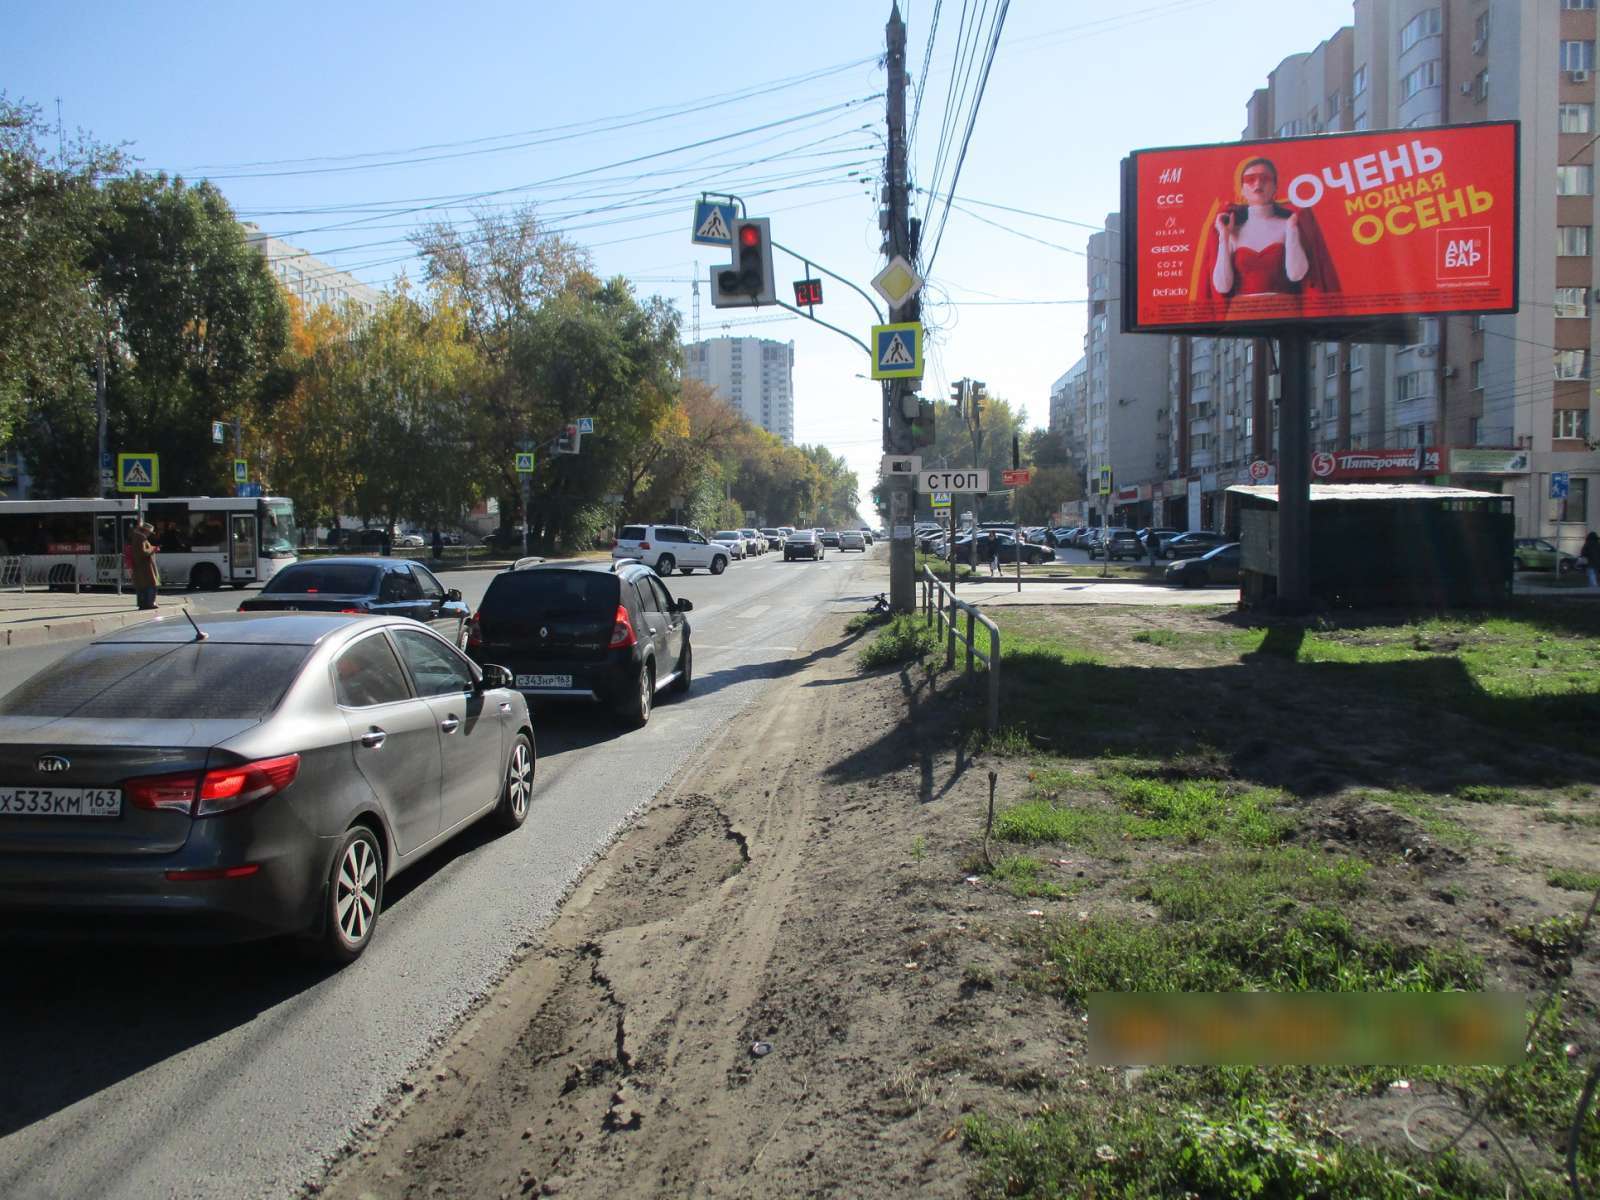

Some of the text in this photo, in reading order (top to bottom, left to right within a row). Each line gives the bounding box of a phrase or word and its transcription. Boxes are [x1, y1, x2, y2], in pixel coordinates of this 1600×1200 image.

[1287, 140, 1443, 208] ОЧЕНЬ
[1156, 193, 1184, 205] CCC
[1344, 171, 1446, 216] МОДНАЯ
[1352, 184, 1494, 245] ОСЕНЬ
[1151, 244, 1189, 254] GEOX
[1444, 252, 1481, 268] БАР
[1156, 268, 1184, 277] HOME
[927, 473, 978, 490] СТОП
[38, 760, 63, 772] KIA
[85, 790, 116, 808] 163
